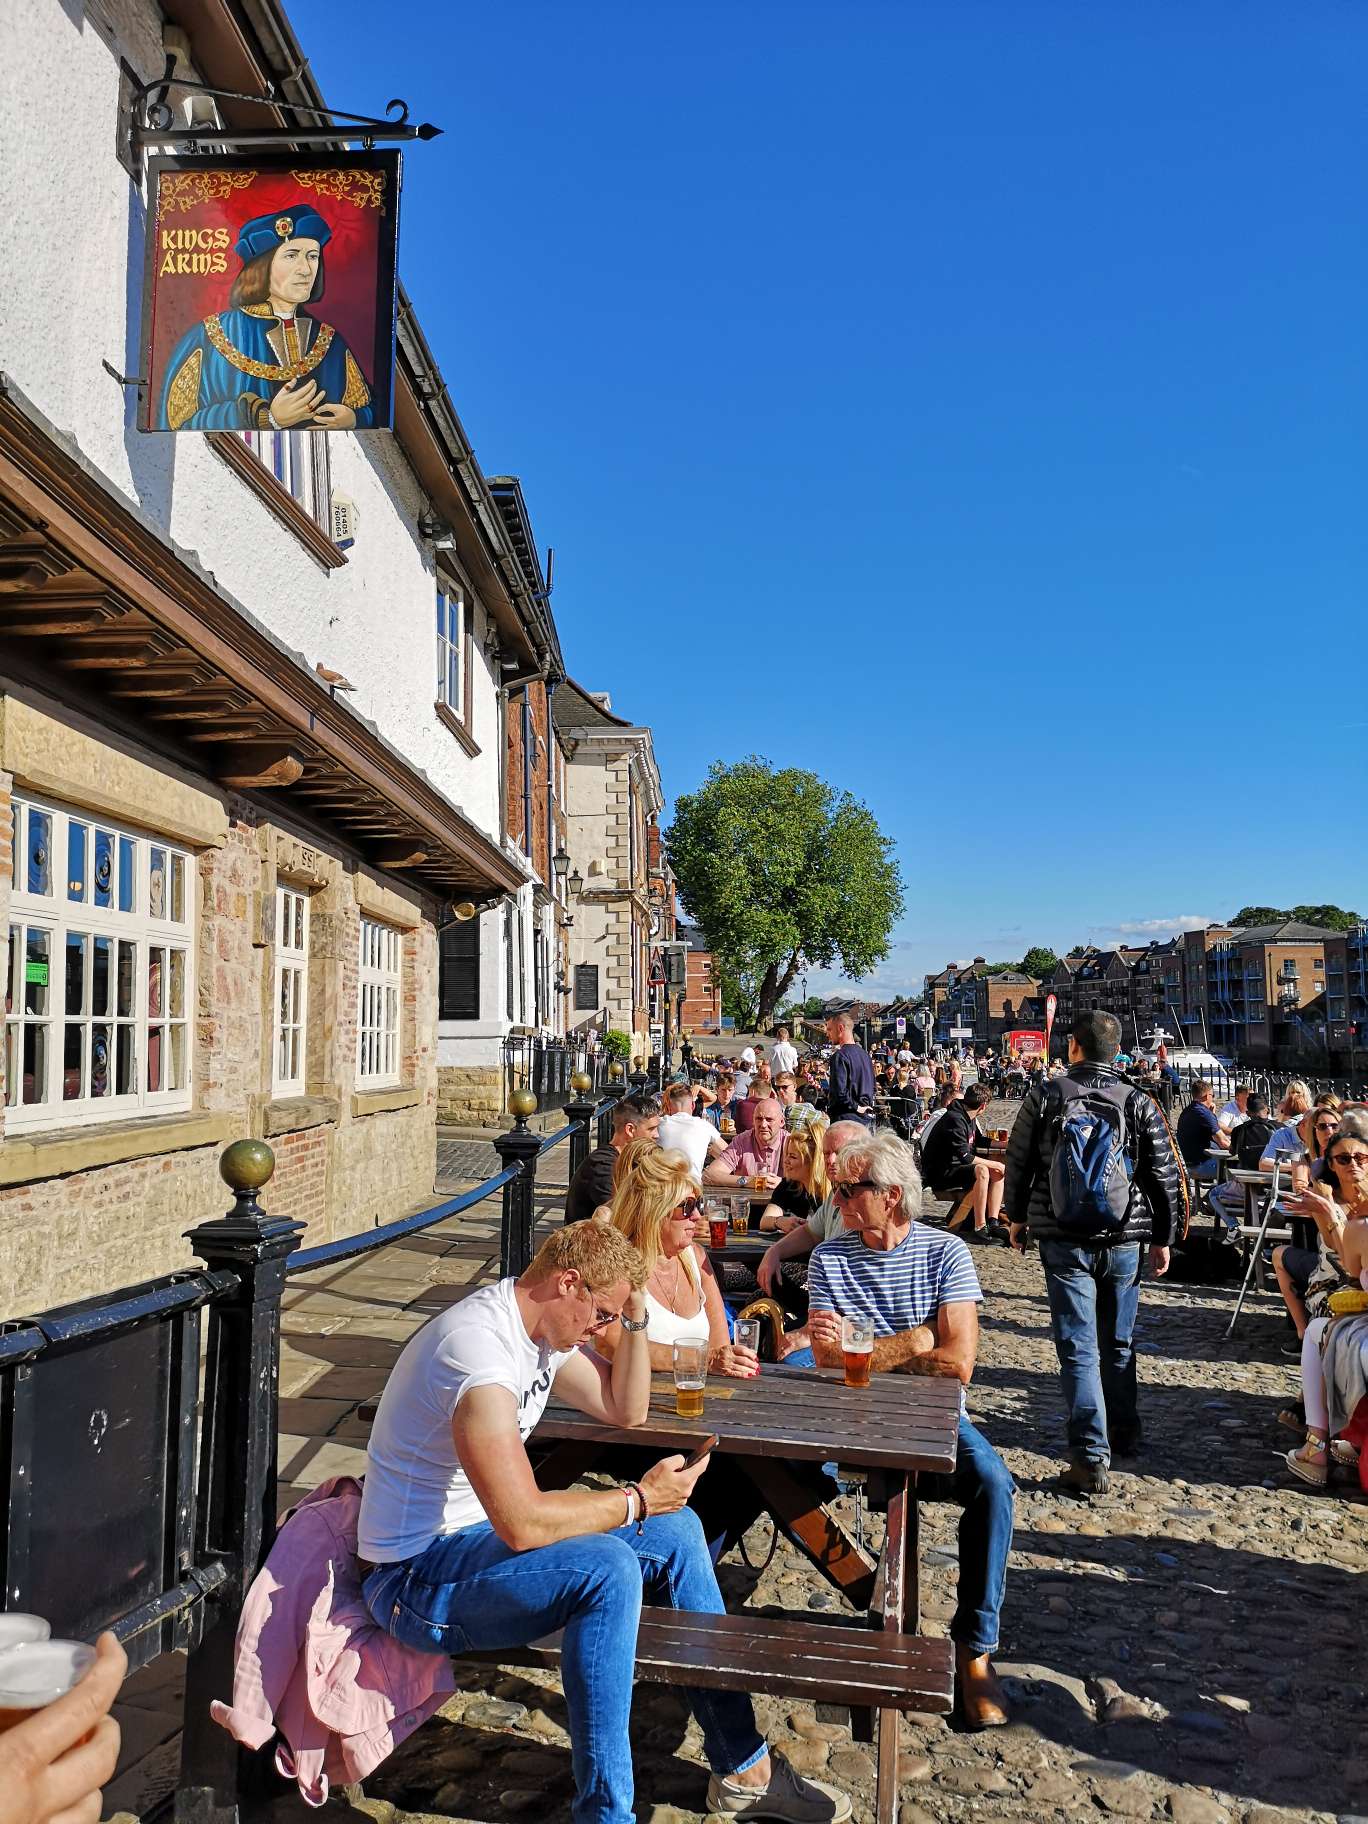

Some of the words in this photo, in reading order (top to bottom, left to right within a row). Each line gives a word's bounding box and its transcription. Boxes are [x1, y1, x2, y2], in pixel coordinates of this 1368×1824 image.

[162, 228, 230, 252] KINGS
[160, 250, 228, 277] ARMS
[341, 507, 349, 535] 01405
